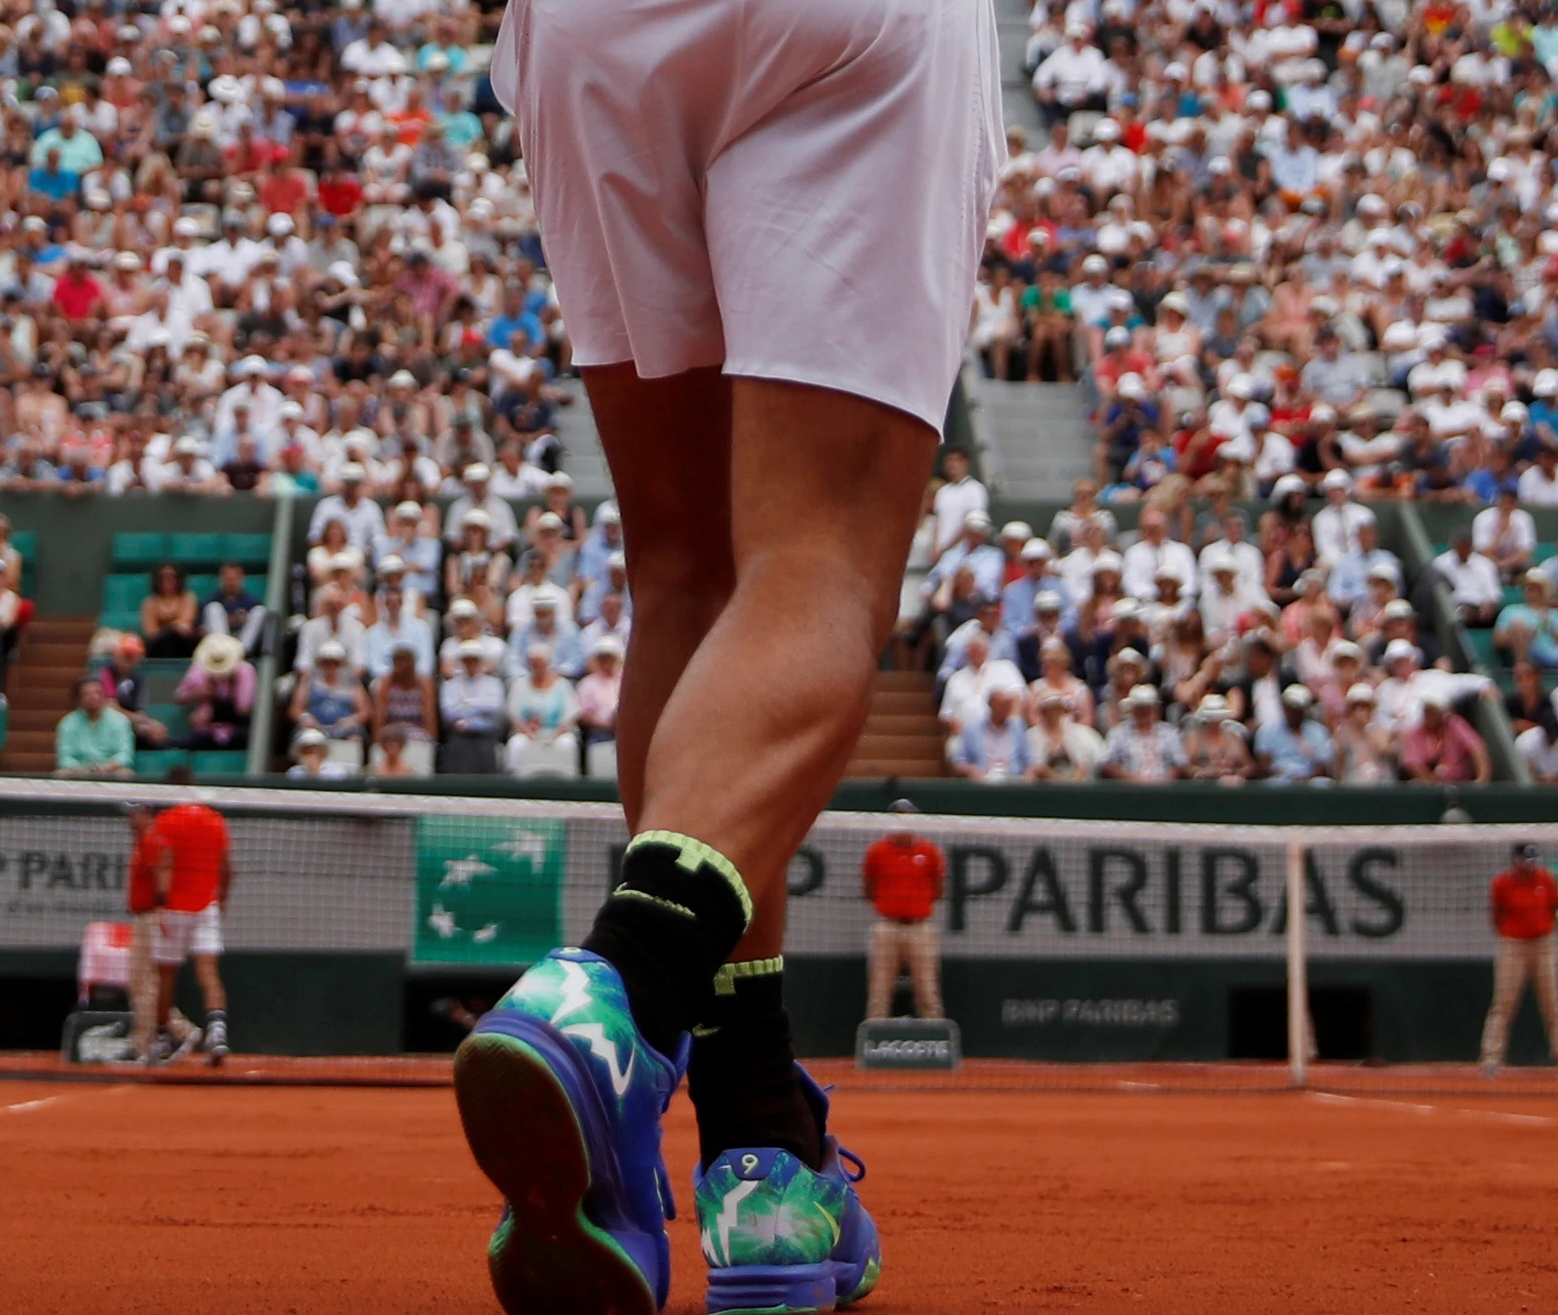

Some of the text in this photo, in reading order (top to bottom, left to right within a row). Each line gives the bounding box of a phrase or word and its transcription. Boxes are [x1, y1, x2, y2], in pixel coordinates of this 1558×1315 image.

[20, 852, 126, 891] PARI
[948, 843, 1405, 938] PARIBAS
[741, 1153, 759, 1175] 9
